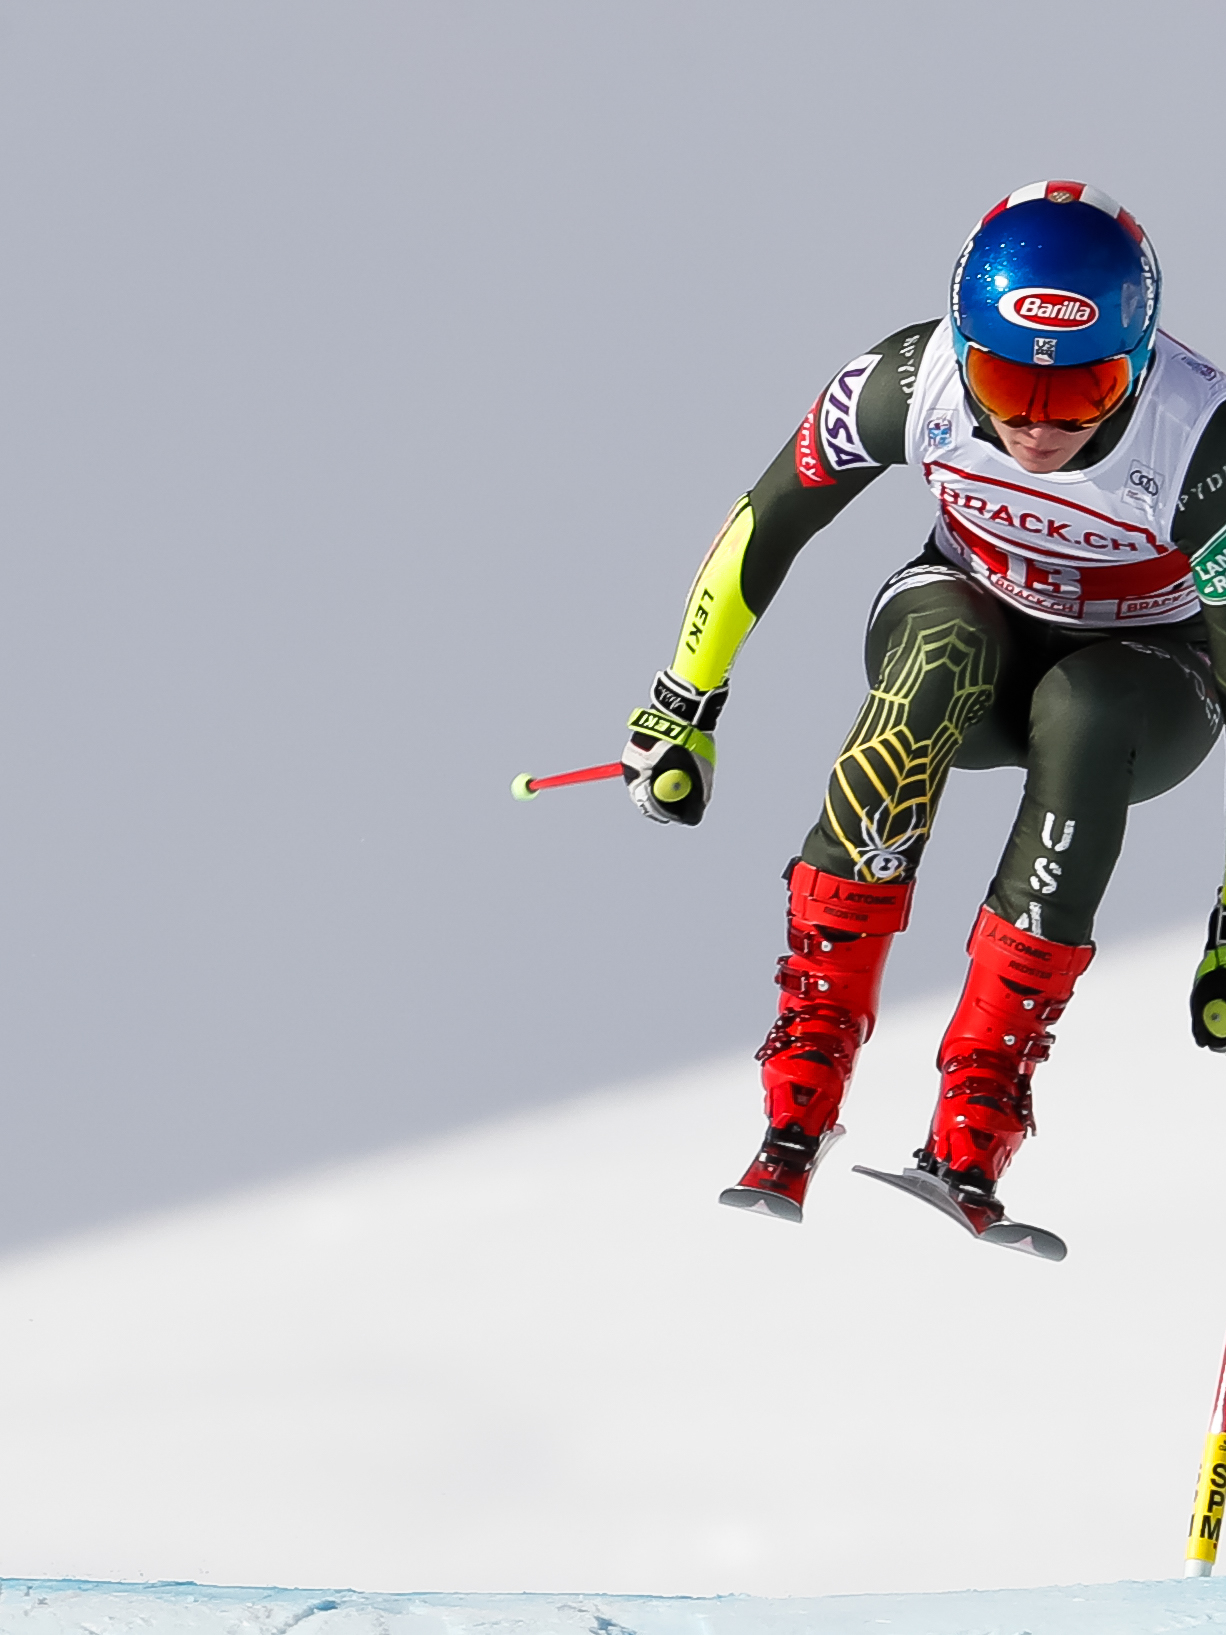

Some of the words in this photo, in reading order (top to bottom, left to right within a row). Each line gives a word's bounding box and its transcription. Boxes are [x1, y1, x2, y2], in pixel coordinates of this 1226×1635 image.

[1019, 297, 1091, 321] Barilla
[824, 358, 875, 468] VISA
[940, 481, 1139, 552] BRACK.CH
[685, 587, 715, 655] LEKI
[638, 713, 682, 737] LEKI
